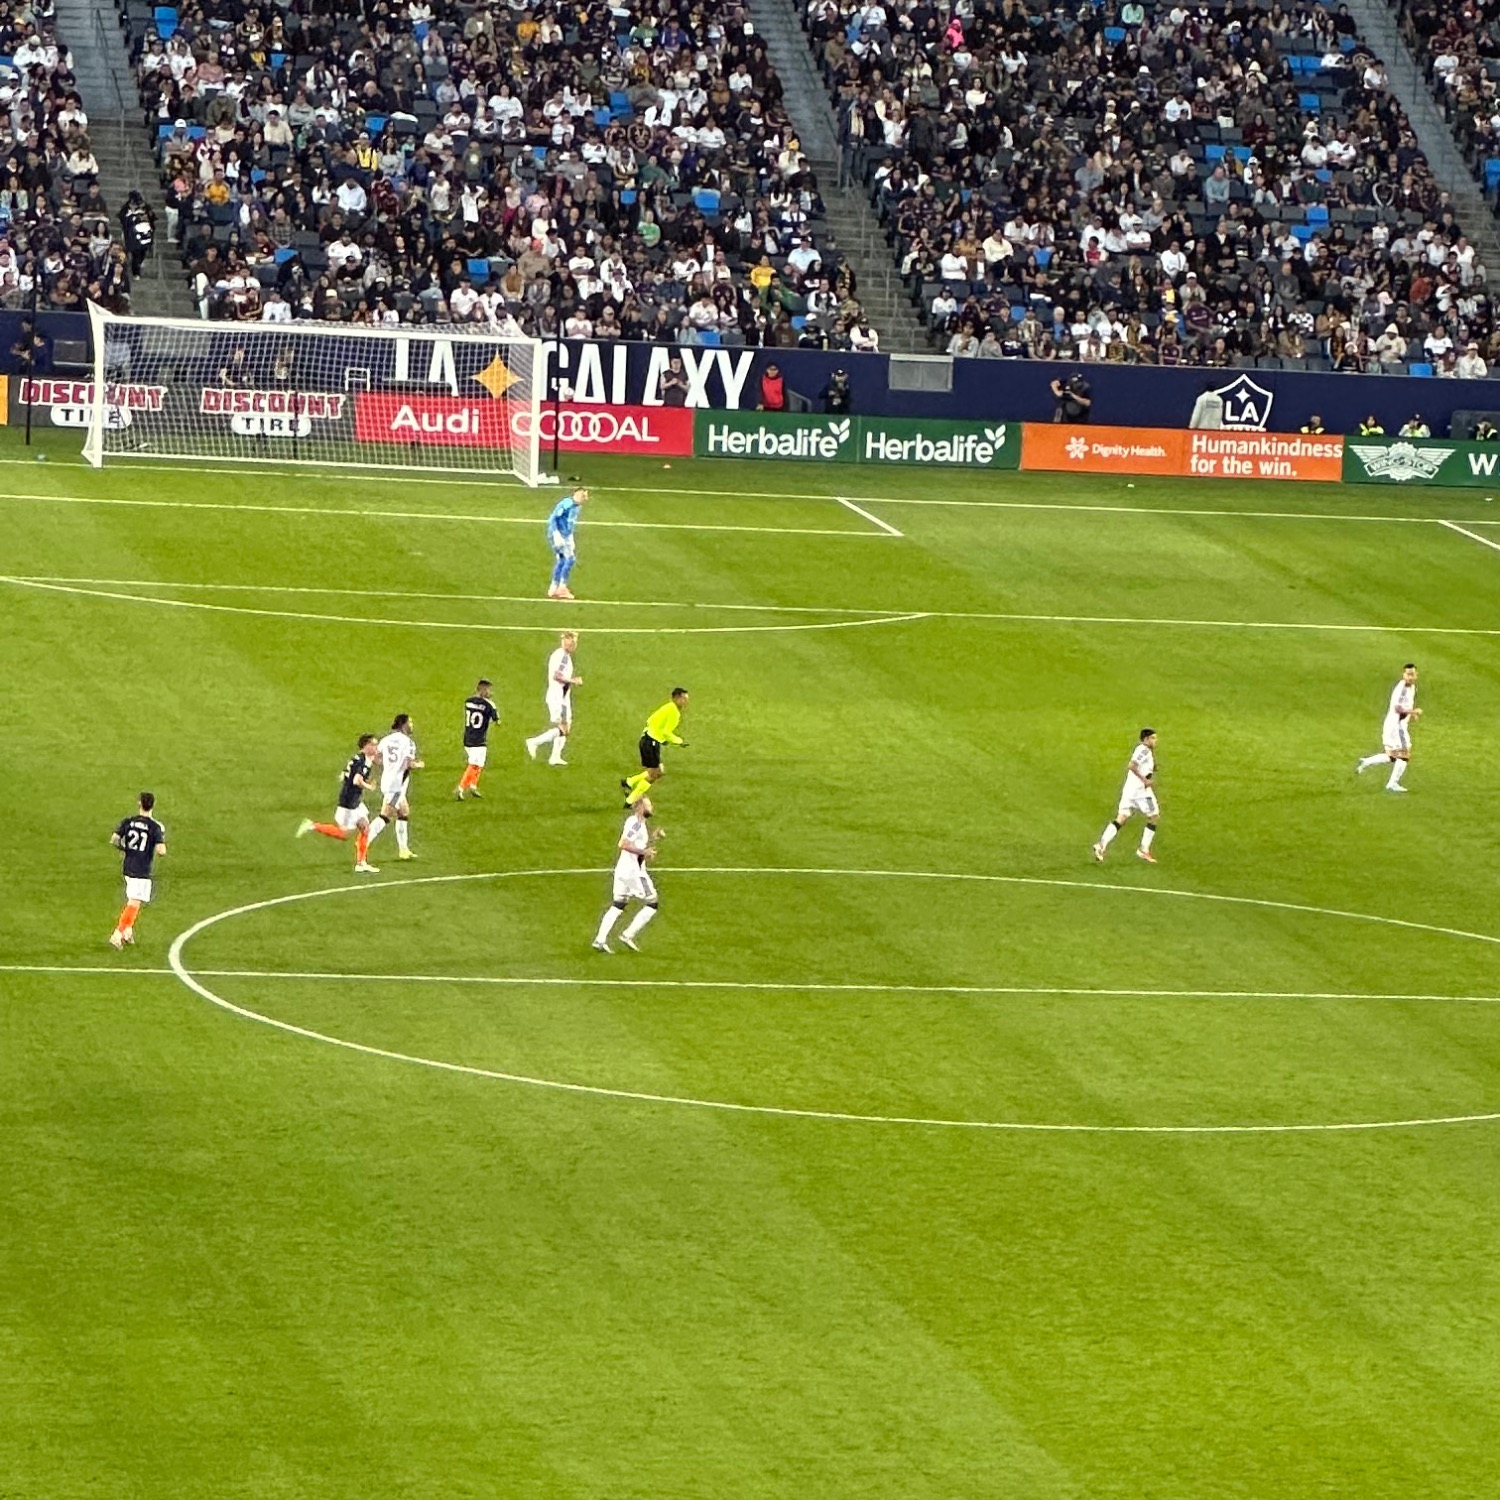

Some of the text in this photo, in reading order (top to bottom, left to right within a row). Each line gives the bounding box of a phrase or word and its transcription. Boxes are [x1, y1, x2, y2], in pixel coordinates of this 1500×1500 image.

[542, 341, 755, 410] GALAXY
[19, 379, 167, 411] DISCUNT
[200, 387, 346, 419] DISCOUNT
[61, 408, 120, 424] TIE
[390, 404, 480, 434] Audi
[1225, 400, 1259, 422] LA
[242, 416, 301, 433] TIRE
[708, 424, 839, 458] Herbalife
[866, 431, 994, 464] Herbalife
[1092, 443, 1130, 458] Dignity
[1192, 434, 1343, 458] Humankindness
[1191, 456, 1297, 476] for the win.
[466, 709, 484, 729] 10
[387, 745, 398, 763] 5
[128, 829, 149, 852] 21
